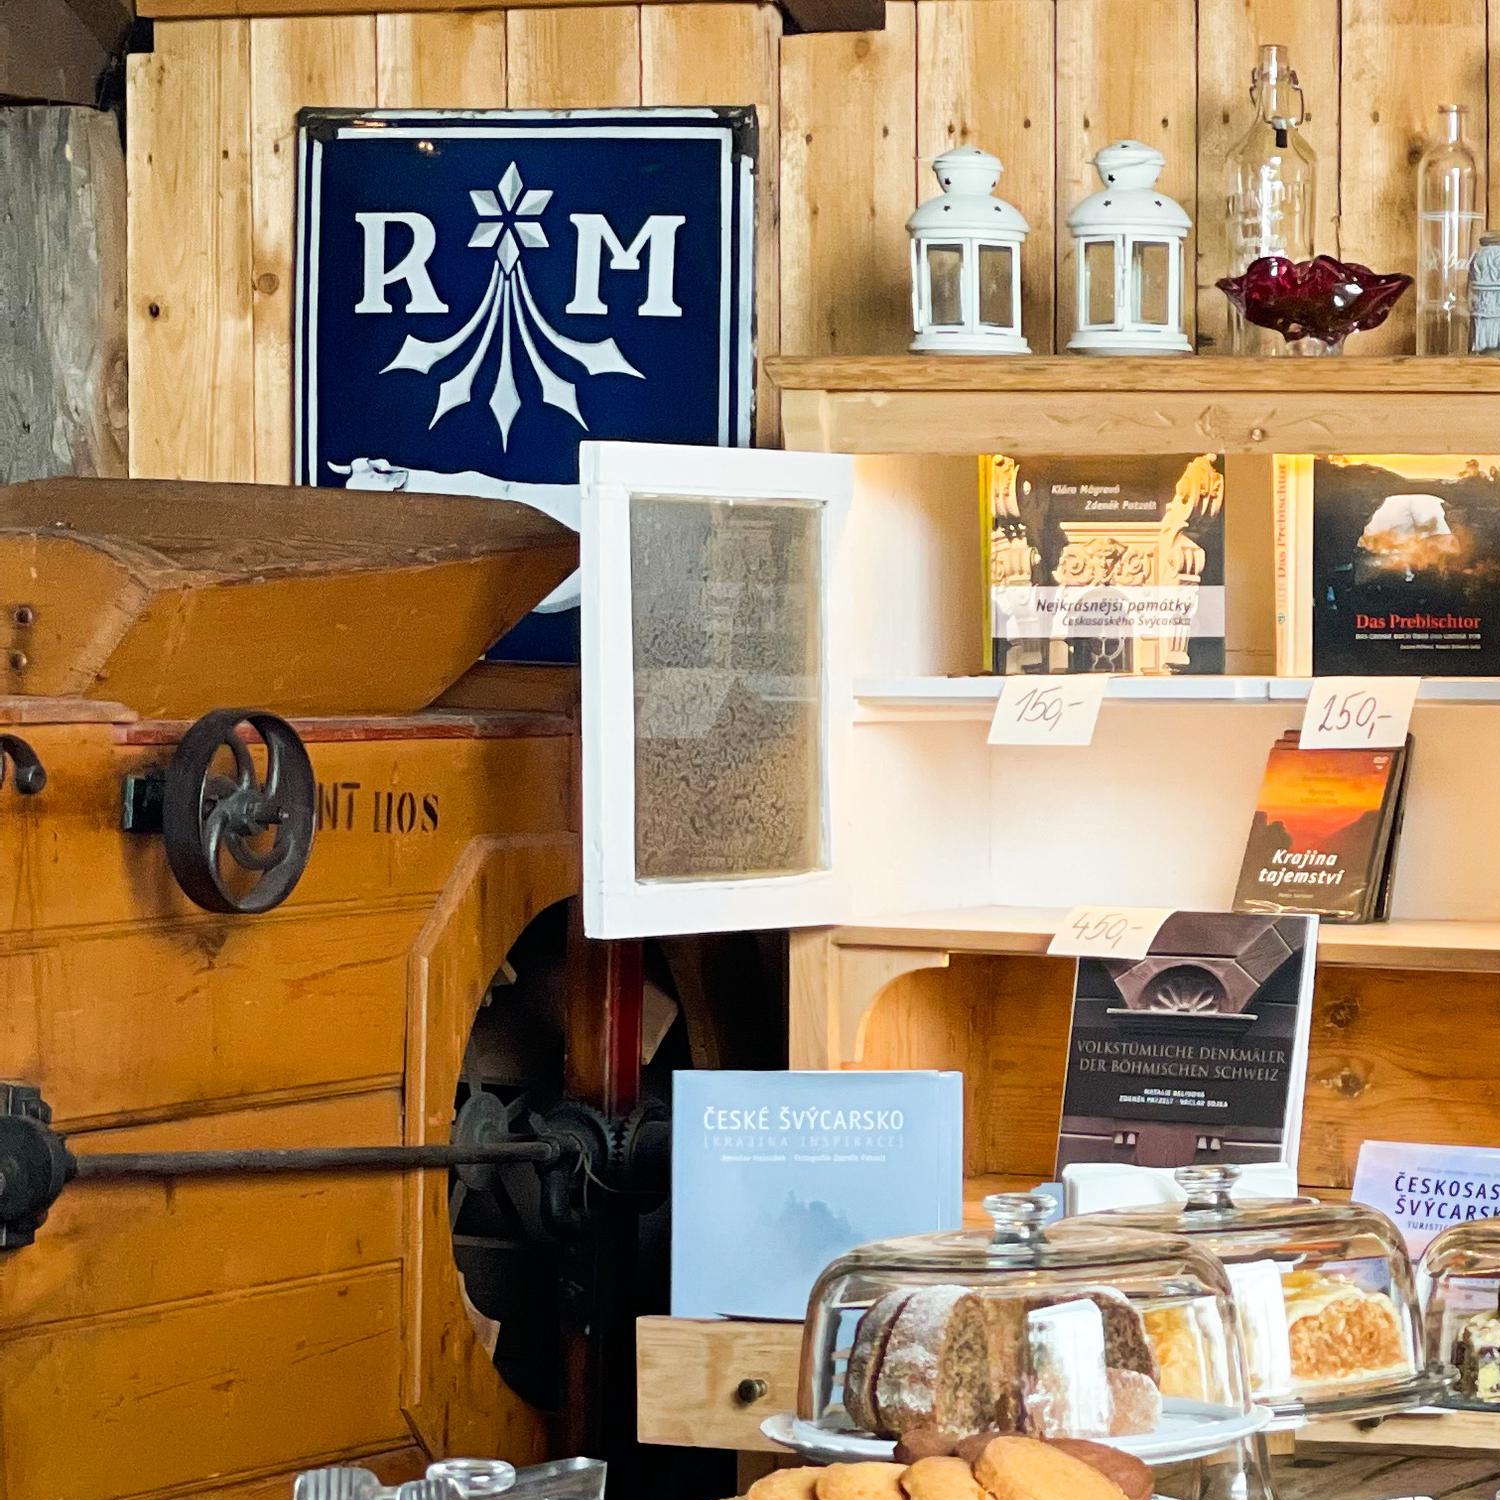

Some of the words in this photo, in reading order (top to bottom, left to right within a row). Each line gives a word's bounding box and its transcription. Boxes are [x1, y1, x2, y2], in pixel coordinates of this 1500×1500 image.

[355, 212, 449, 313] R
[566, 213, 686, 316] M
[1036, 598, 1124, 614] Nejkrásnější
[1127, 600, 1191, 615] památky
[1356, 614, 1386, 629] Das
[1390, 613, 1481, 629] Prebischtor
[1015, 686, 1084, 732] 150,-
[1272, 849, 1338, 868] Krajina
[1258, 868, 1345, 887] tajemství
[1072, 911, 1144, 950] 450,-
[1077, 1039, 1195, 1060] VOLKSTÜMLICHE
[1199, 1047, 1286, 1064] DENKMÄLER
[1079, 1058, 1106, 1073] DER
[1111, 1059, 1209, 1078] BÖHMISCHEN
[1214, 1067, 1279, 1082] SCHWEIZ
[703, 1106, 770, 1131] ČESKÉ
[779, 1106, 904, 1131] ŠVÝCARSKO
